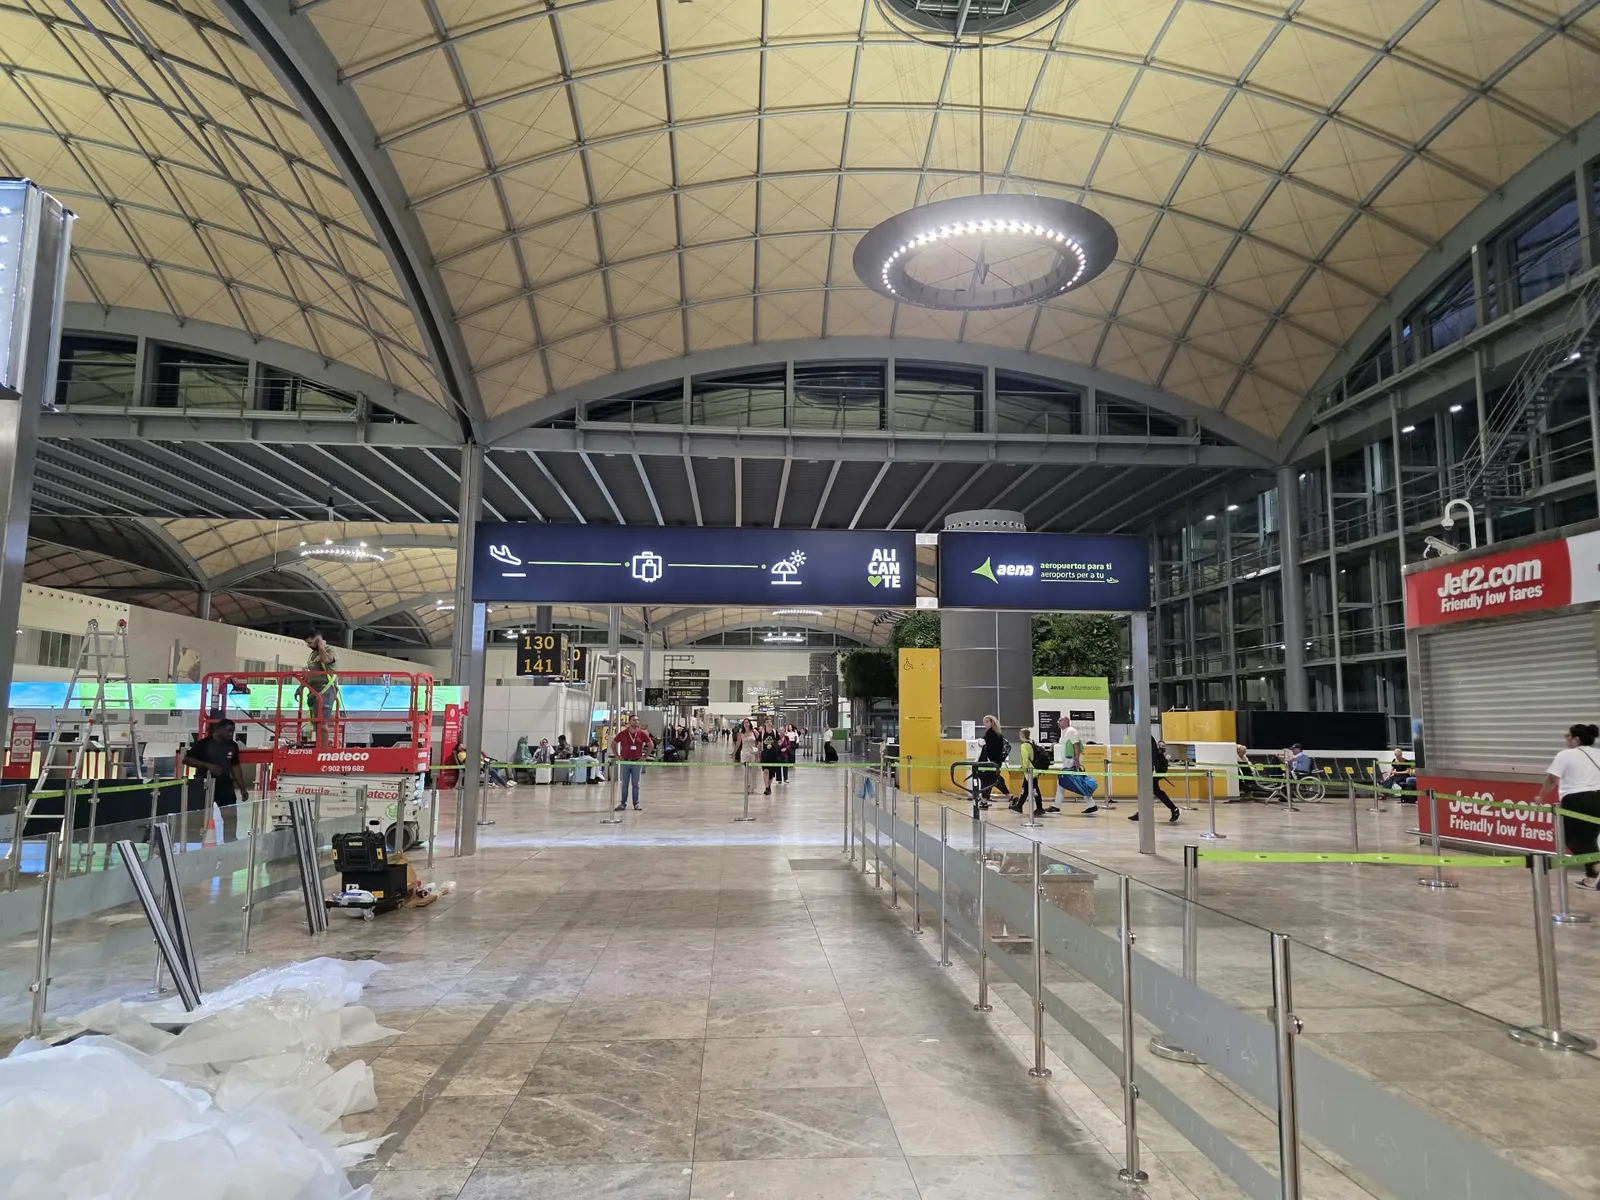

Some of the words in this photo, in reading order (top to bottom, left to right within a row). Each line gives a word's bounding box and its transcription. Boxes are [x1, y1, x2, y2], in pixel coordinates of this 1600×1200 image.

[871, 548, 896, 562] ALI
[868, 561, 900, 575] CAN
[996, 564, 1034, 576] aena
[1040, 562, 1086, 571] aeropuertos
[1087, 563, 1105, 571] para
[1106, 562, 1112, 570] ti
[882, 574, 901, 588] TE
[1040, 571, 1076, 579] aeroports
[1437, 558, 1542, 597] Jet2.com
[1440, 594, 1483, 613] Friendly
[1485, 590, 1506, 606] low
[1509, 584, 1543, 602] fares
[524, 635, 555, 650] 130
[524, 658, 553, 673] 141
[317, 751, 370, 762] mateco
[366, 789, 398, 799] ateco
[1449, 790, 1553, 824] Jet2.com
[1450, 815, 1494, 837] Friendly
[1496, 820, 1518, 837] low
[1520, 823, 1554, 842] fares
